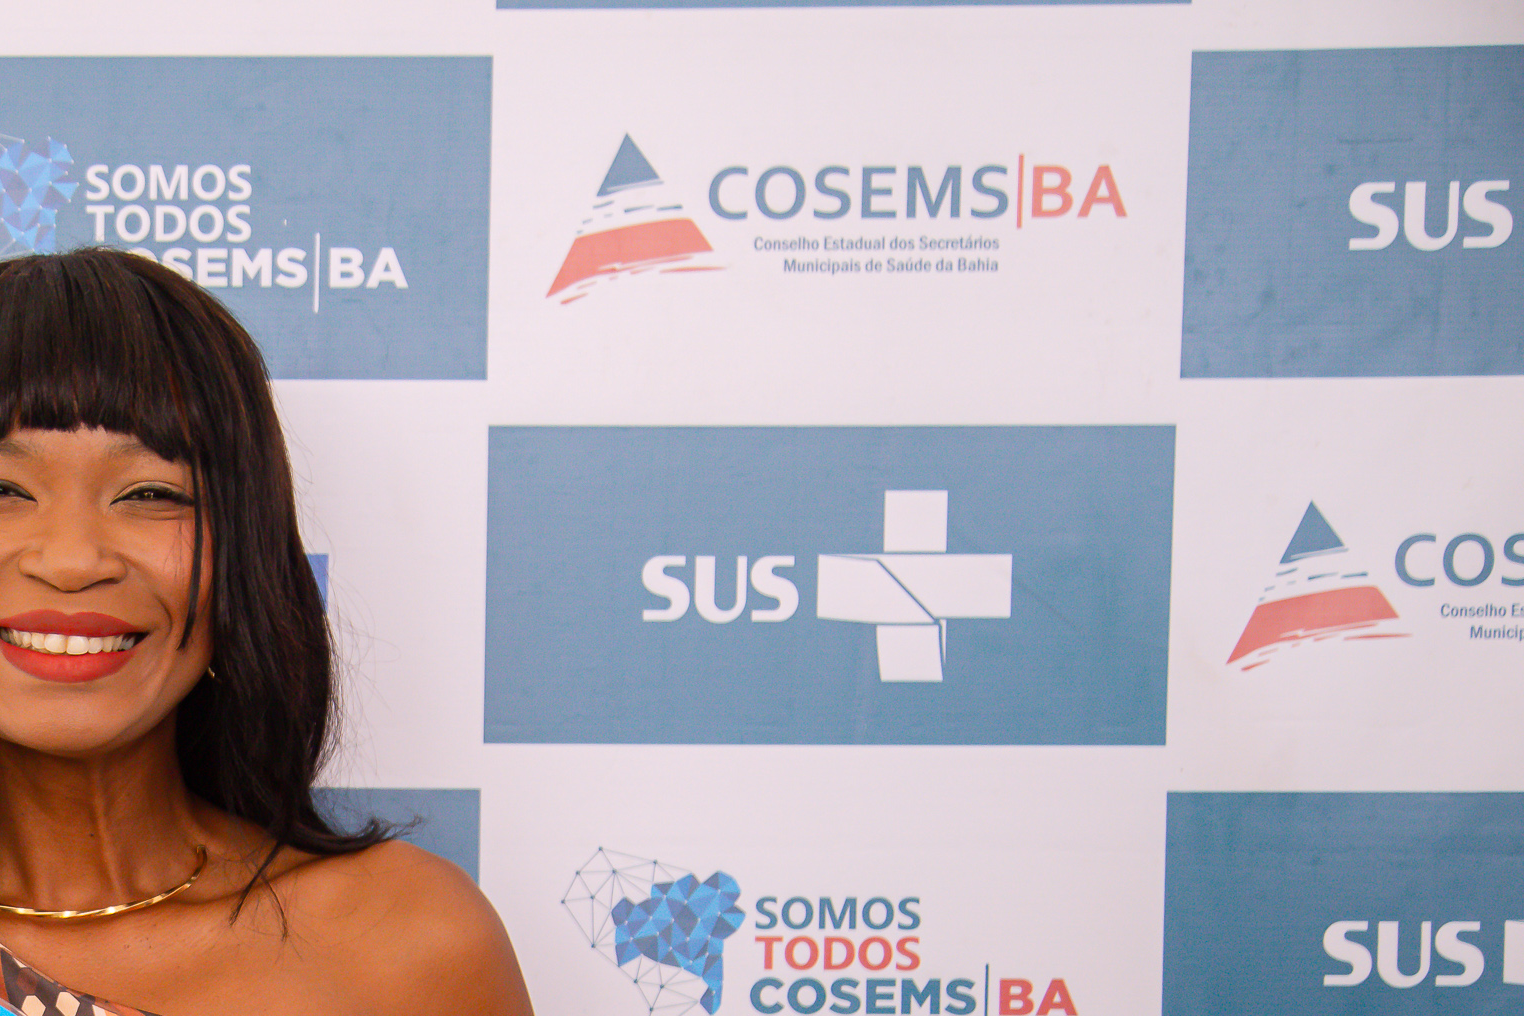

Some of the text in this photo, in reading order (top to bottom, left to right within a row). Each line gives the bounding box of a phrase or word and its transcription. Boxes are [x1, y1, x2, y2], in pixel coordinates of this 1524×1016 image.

[86, 164, 252, 200] SOMOS
[86, 205, 251, 242] TODOS
[1349, 180, 1513, 250] SUS
[754, 236, 999, 250] Conselho Estadual dos Secretários
[784, 258, 998, 275] Municipais de Saúde da Bahia
[642, 556, 799, 623] SUS
[1441, 604, 1506, 617] Conselho
[756, 896, 920, 930] SOMOS
[755, 936, 921, 971] TODOS
[1323, 921, 1484, 988] SUS
